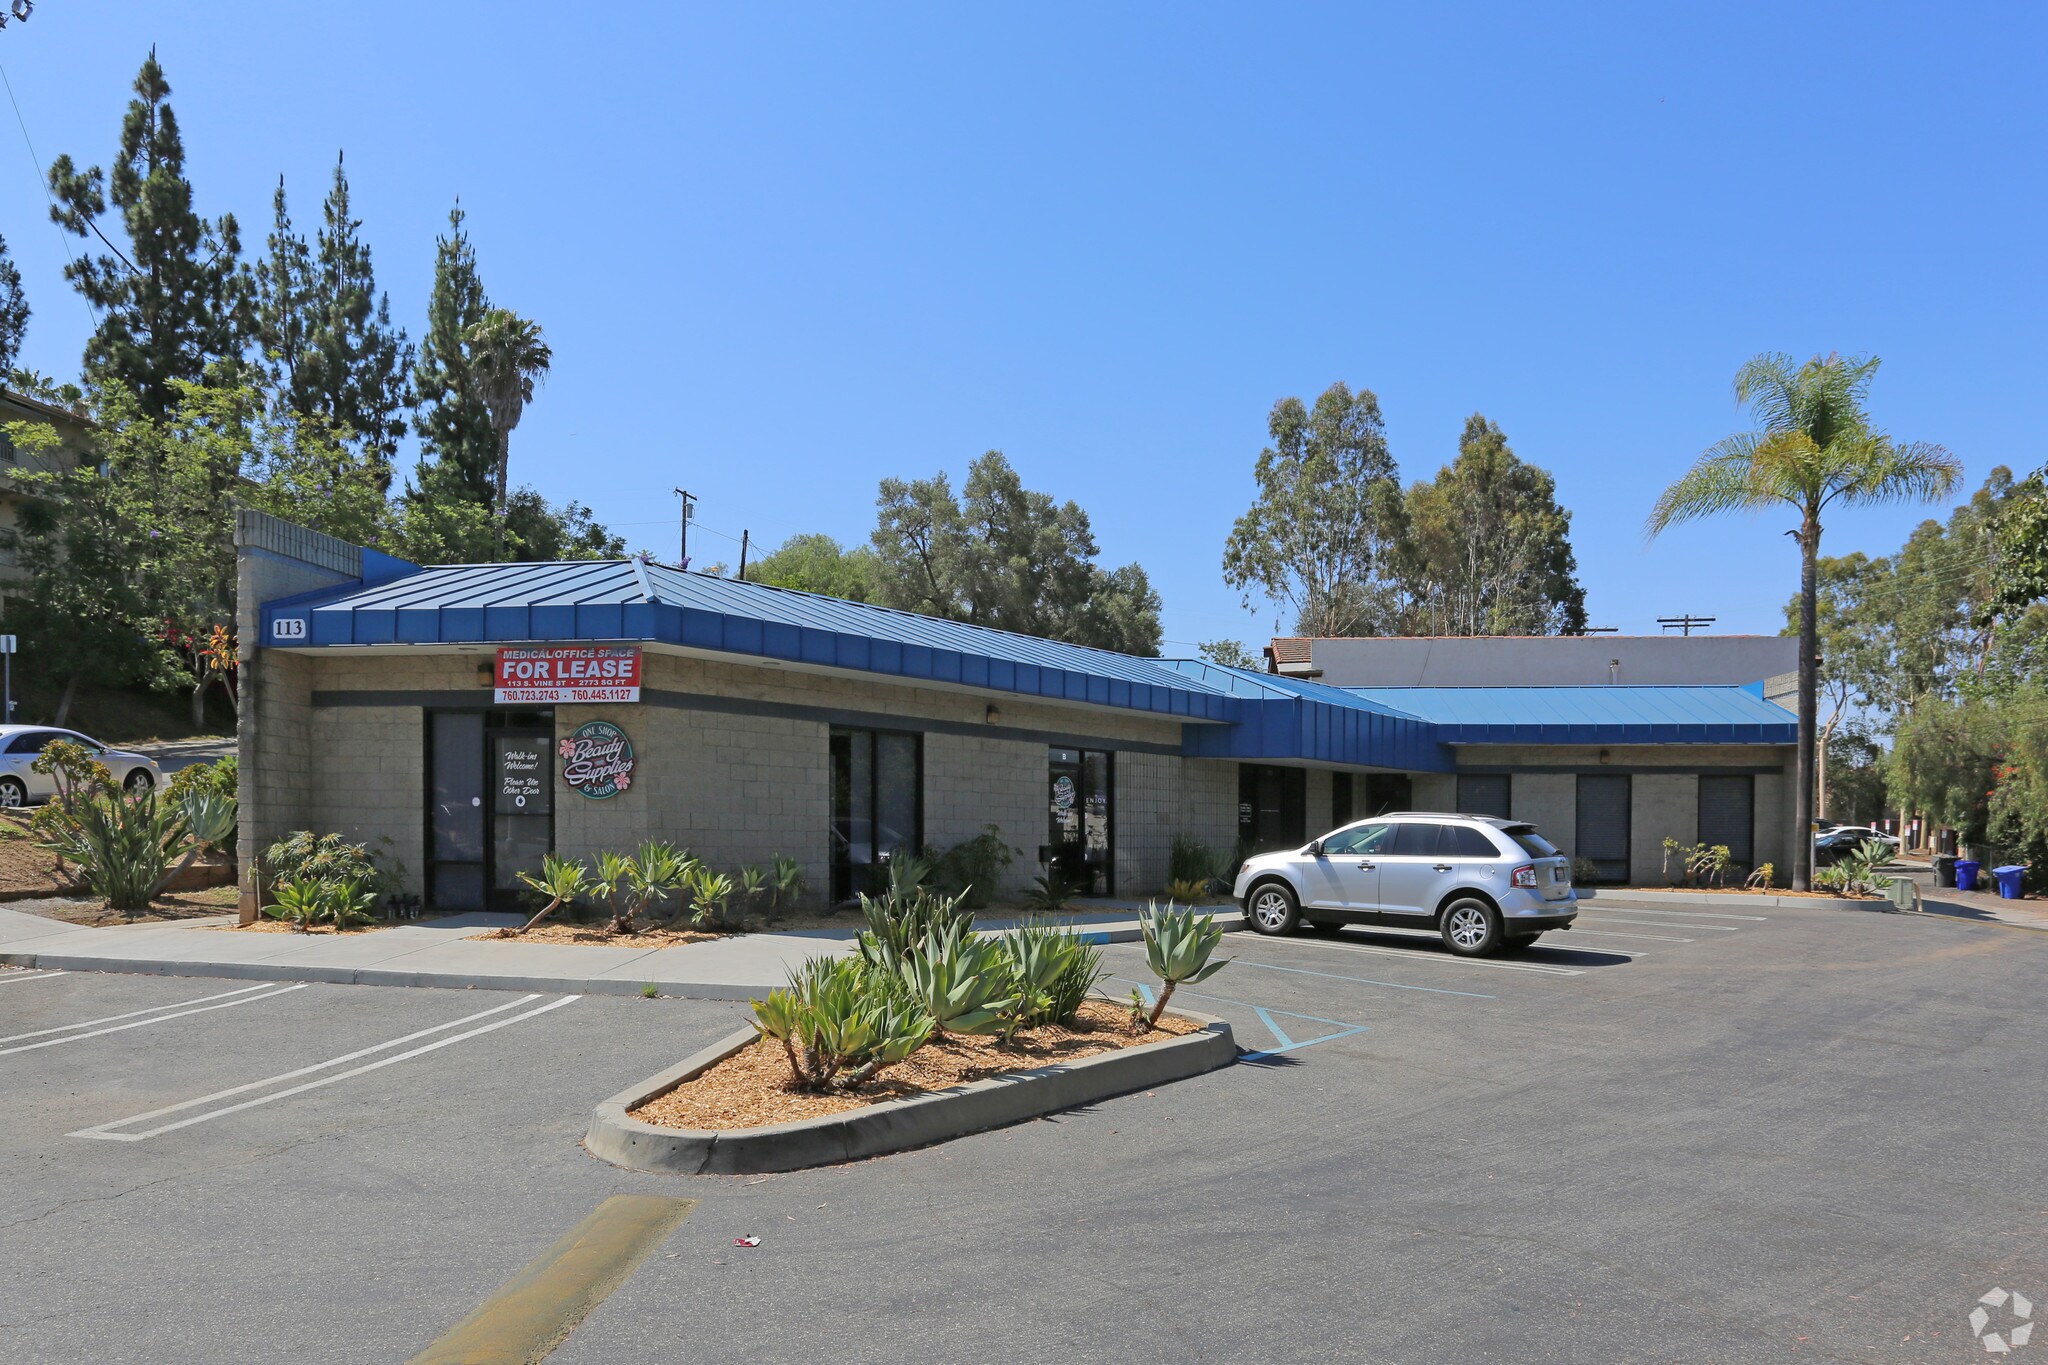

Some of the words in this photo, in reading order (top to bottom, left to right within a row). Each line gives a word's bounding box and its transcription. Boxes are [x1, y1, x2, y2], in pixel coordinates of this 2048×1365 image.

[276, 620, 302, 636] 113
[503, 649, 595, 660] MEDICAL/OFFICE
[597, 648, 634, 658] SPACE
[502, 661, 550, 679] FOR
[557, 659, 633, 679] LEASE
[502, 690, 560, 701] 760.723.2743
[571, 689, 632, 700] 760.445.1127
[582, 726, 596, 738] ONE
[598, 725, 617, 738] SHOP
[571, 736, 625, 763] Beauty
[504, 761, 539, 770] Welcome!
[564, 756, 634, 785] Supplies
[504, 777, 525, 786] Please
[502, 786, 521, 795] Other
[522, 786, 540, 795] Door
[583, 783, 592, 792] &
[593, 782, 616, 796] SALON
